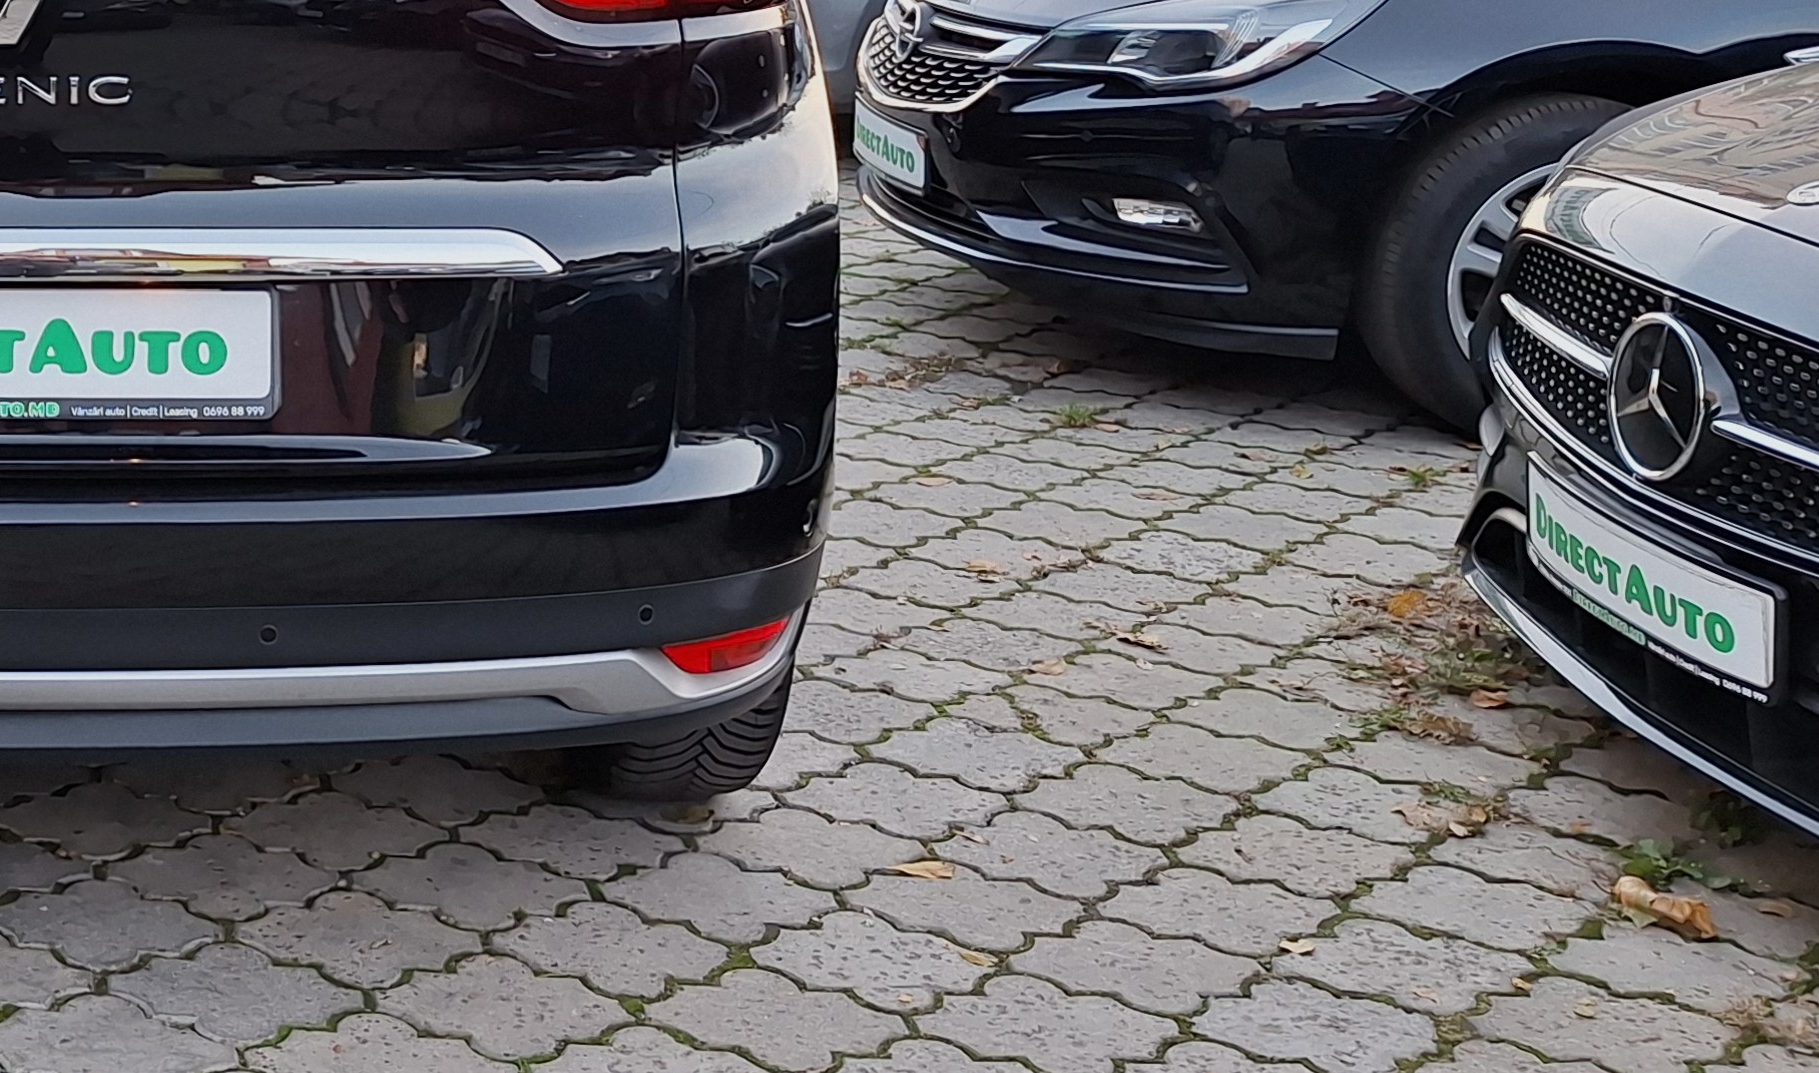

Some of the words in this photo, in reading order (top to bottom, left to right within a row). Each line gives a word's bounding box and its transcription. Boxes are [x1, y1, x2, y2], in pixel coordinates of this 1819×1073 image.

[104, 406, 125, 417] auto
[202, 405, 230, 417] 0696
[245, 405, 266, 417] 999
